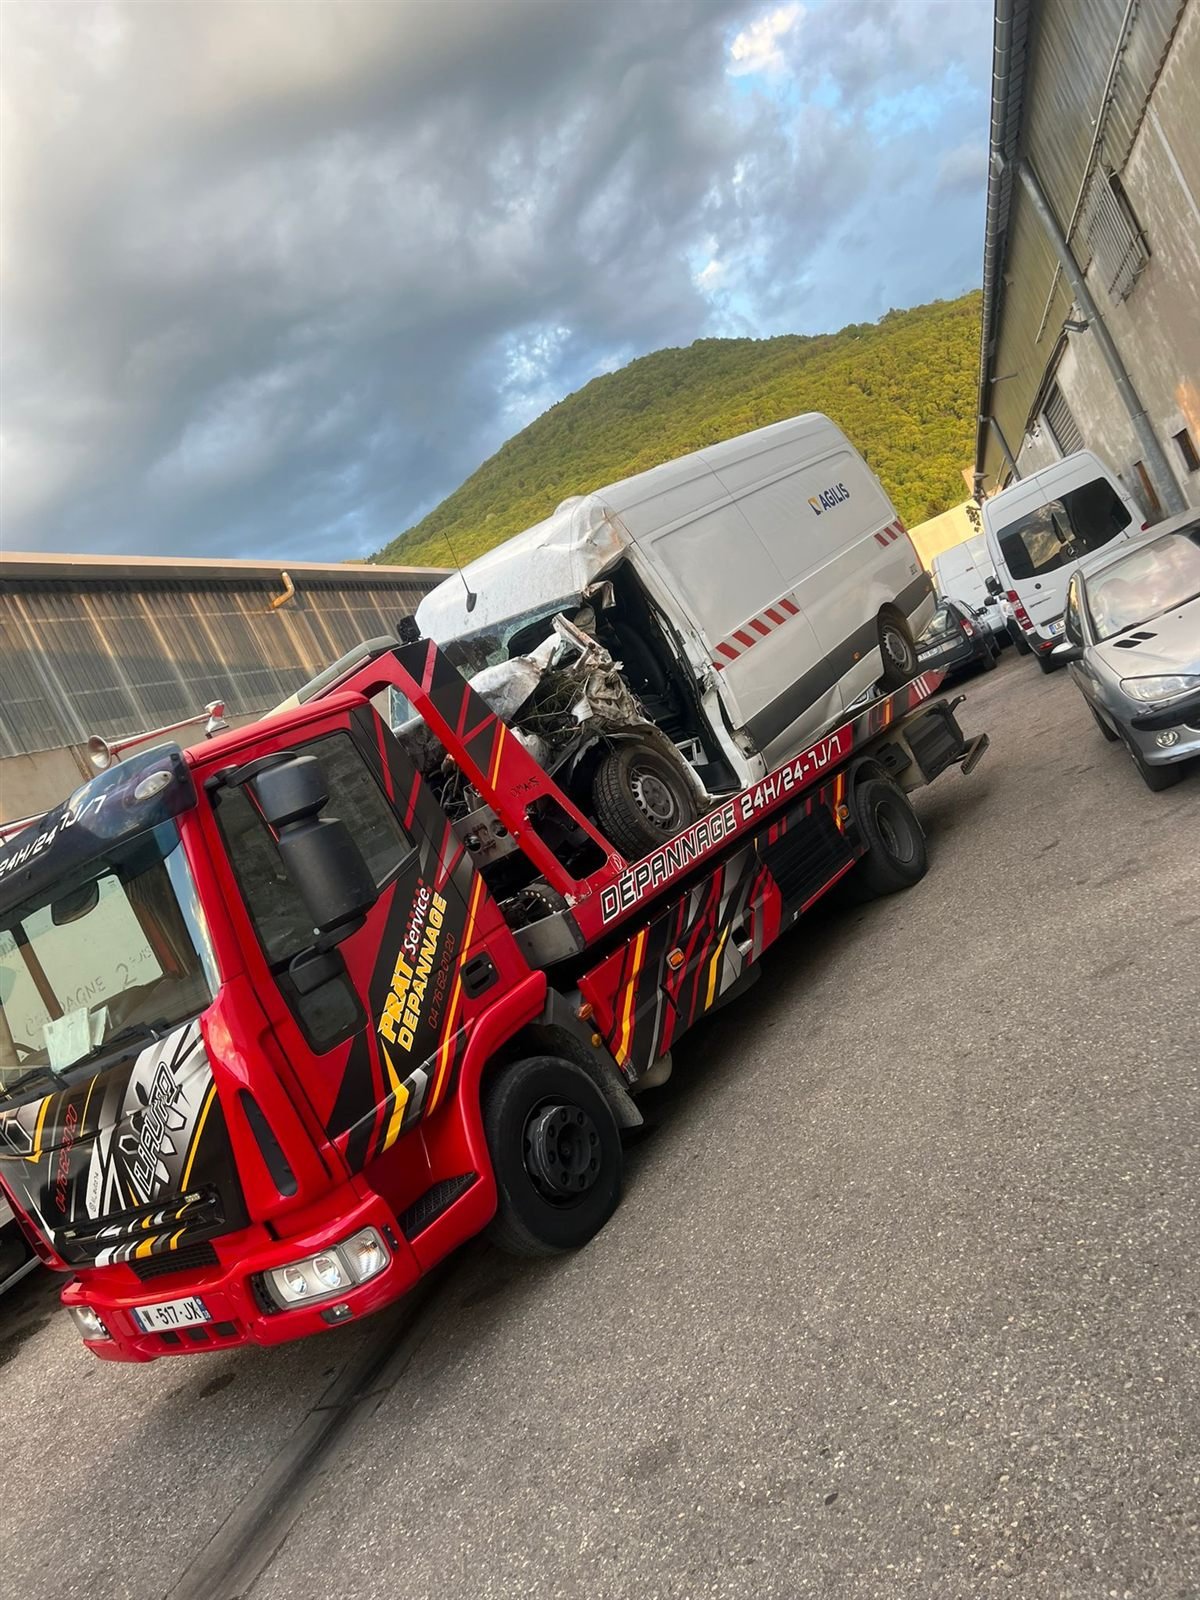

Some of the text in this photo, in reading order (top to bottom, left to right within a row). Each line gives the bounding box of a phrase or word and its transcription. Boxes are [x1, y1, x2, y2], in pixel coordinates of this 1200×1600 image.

[818, 482, 850, 511] AGILIS
[600, 735, 842, 925] DÉPANNAGE 24H/24-7J/7
[445, 932, 456, 953] 20
[377, 887, 430, 1045] PRAT Service
[397, 892, 448, 1053] DEPANNAGE
[436, 969, 448, 989] 62
[432, 988, 444, 1009] 76
[428, 1007, 440, 1029] 04
